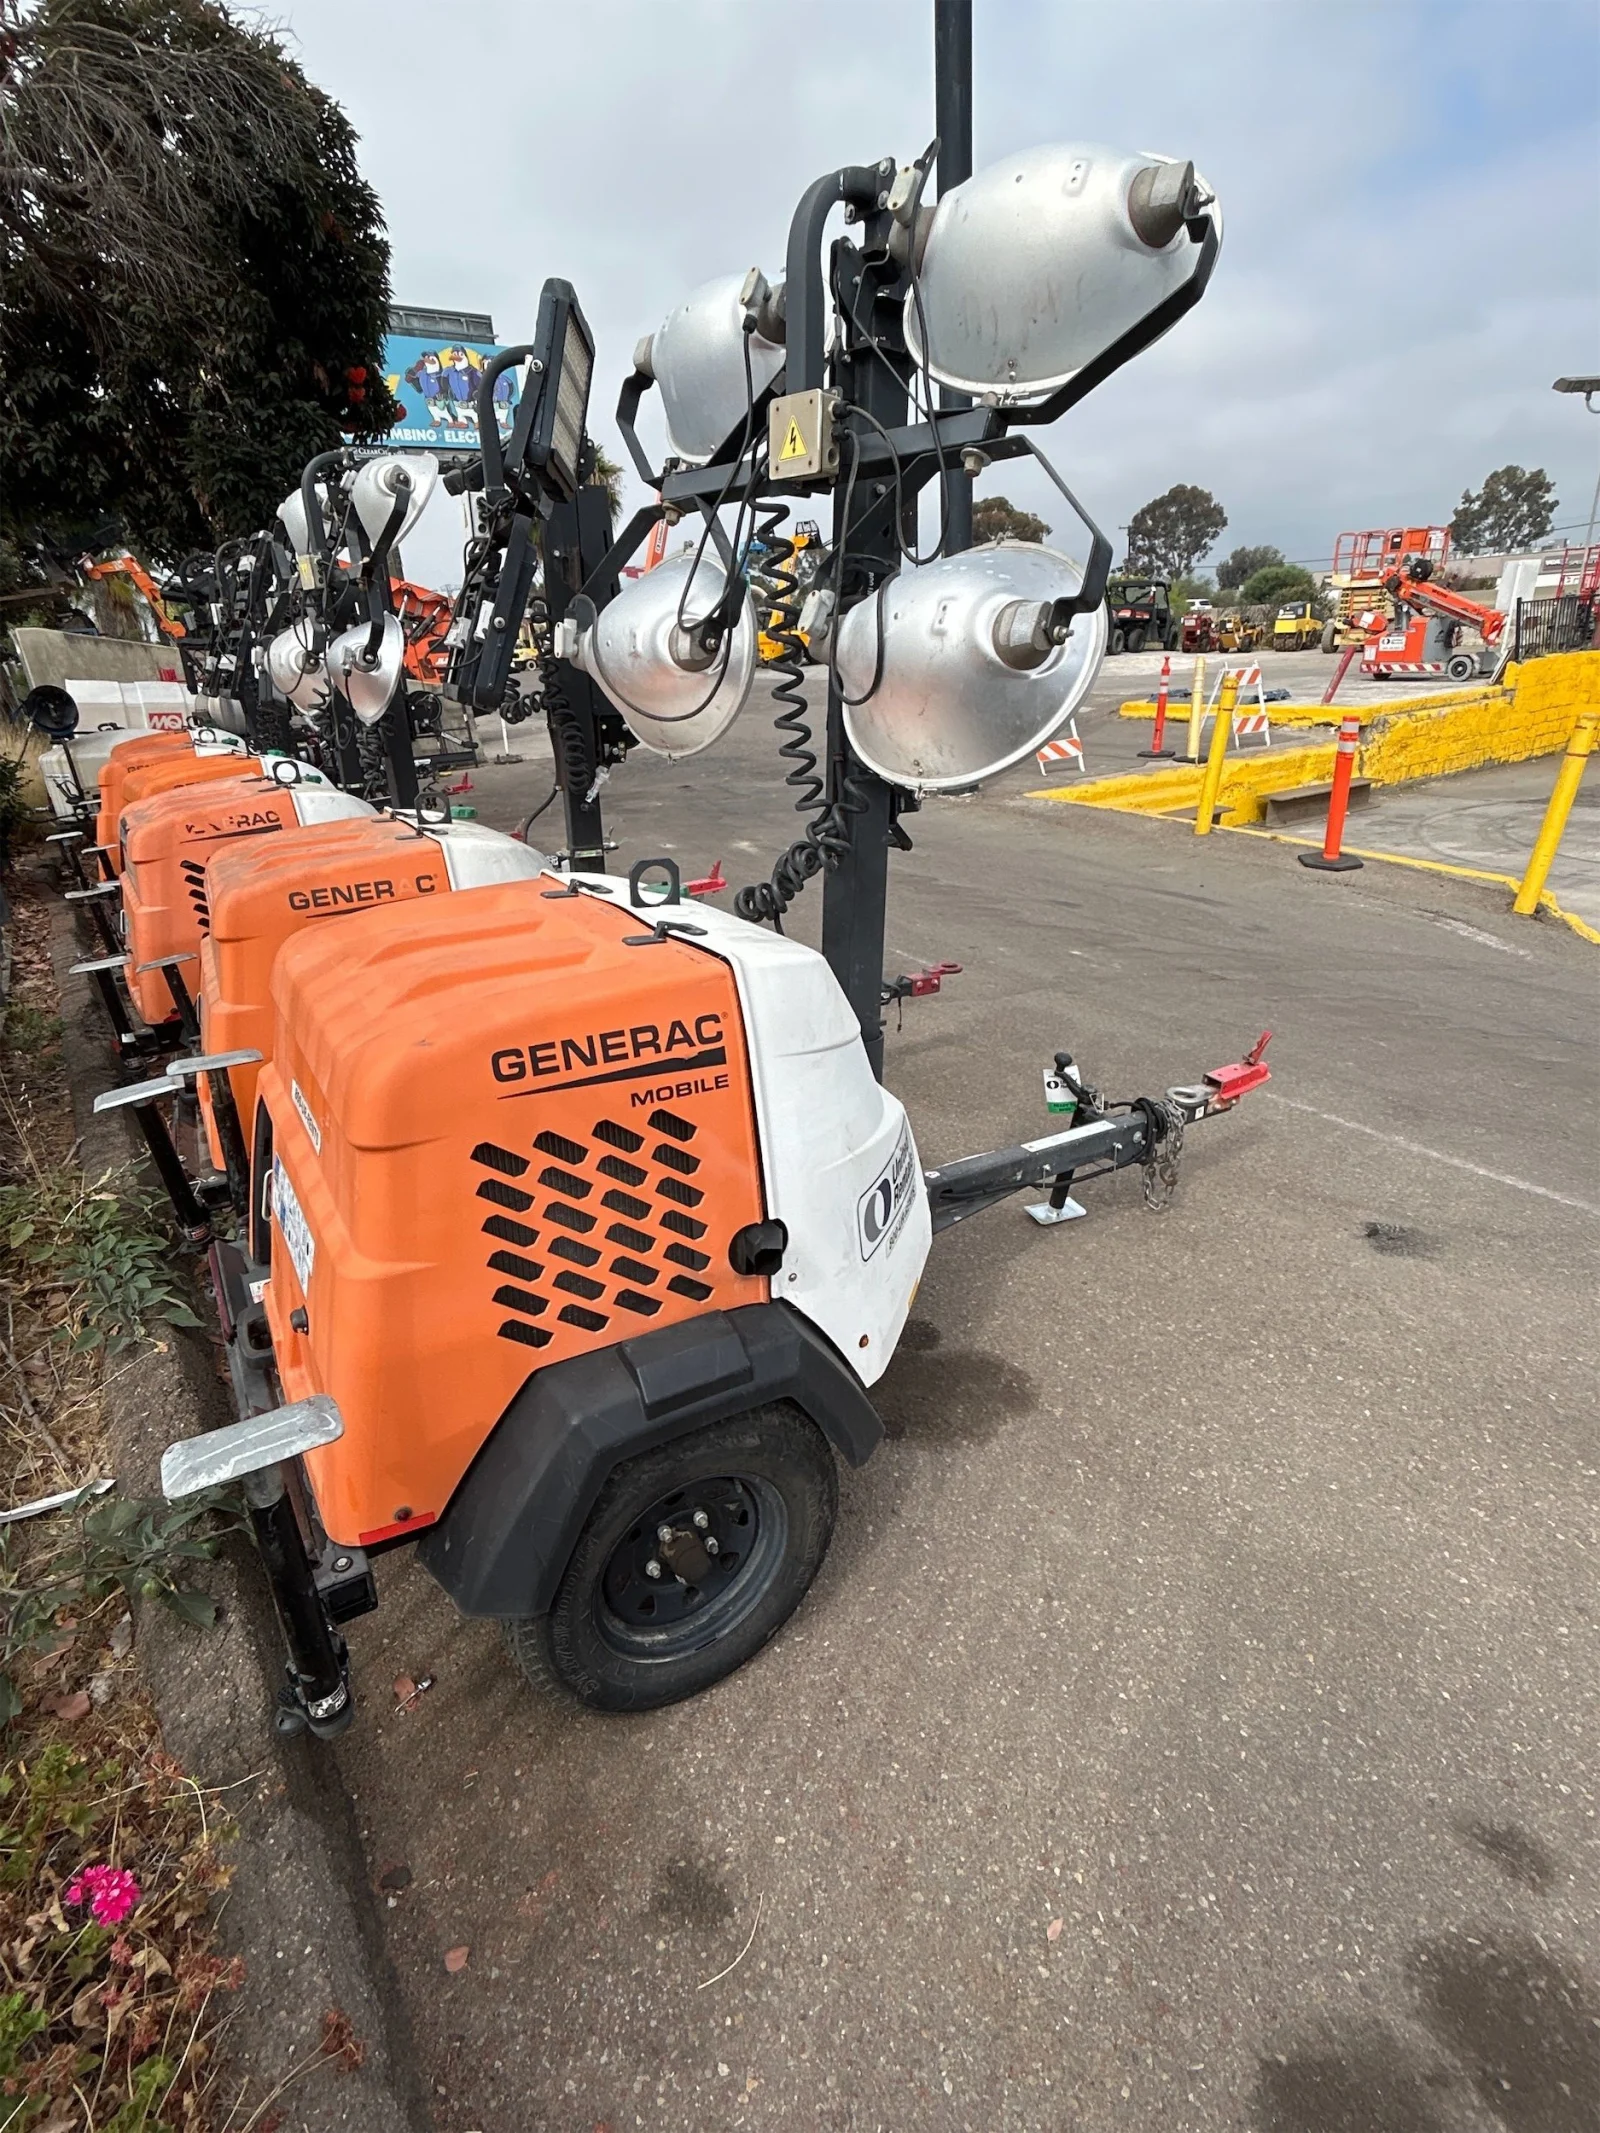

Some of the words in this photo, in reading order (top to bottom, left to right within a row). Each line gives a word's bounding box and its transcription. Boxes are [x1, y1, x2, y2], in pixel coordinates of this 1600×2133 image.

[383, 428, 437, 442] MBING
[288, 874, 436, 911] GENERC
[491, 1013, 724, 1083] GENERAC
[630, 1074, 730, 1108] MOBILE
